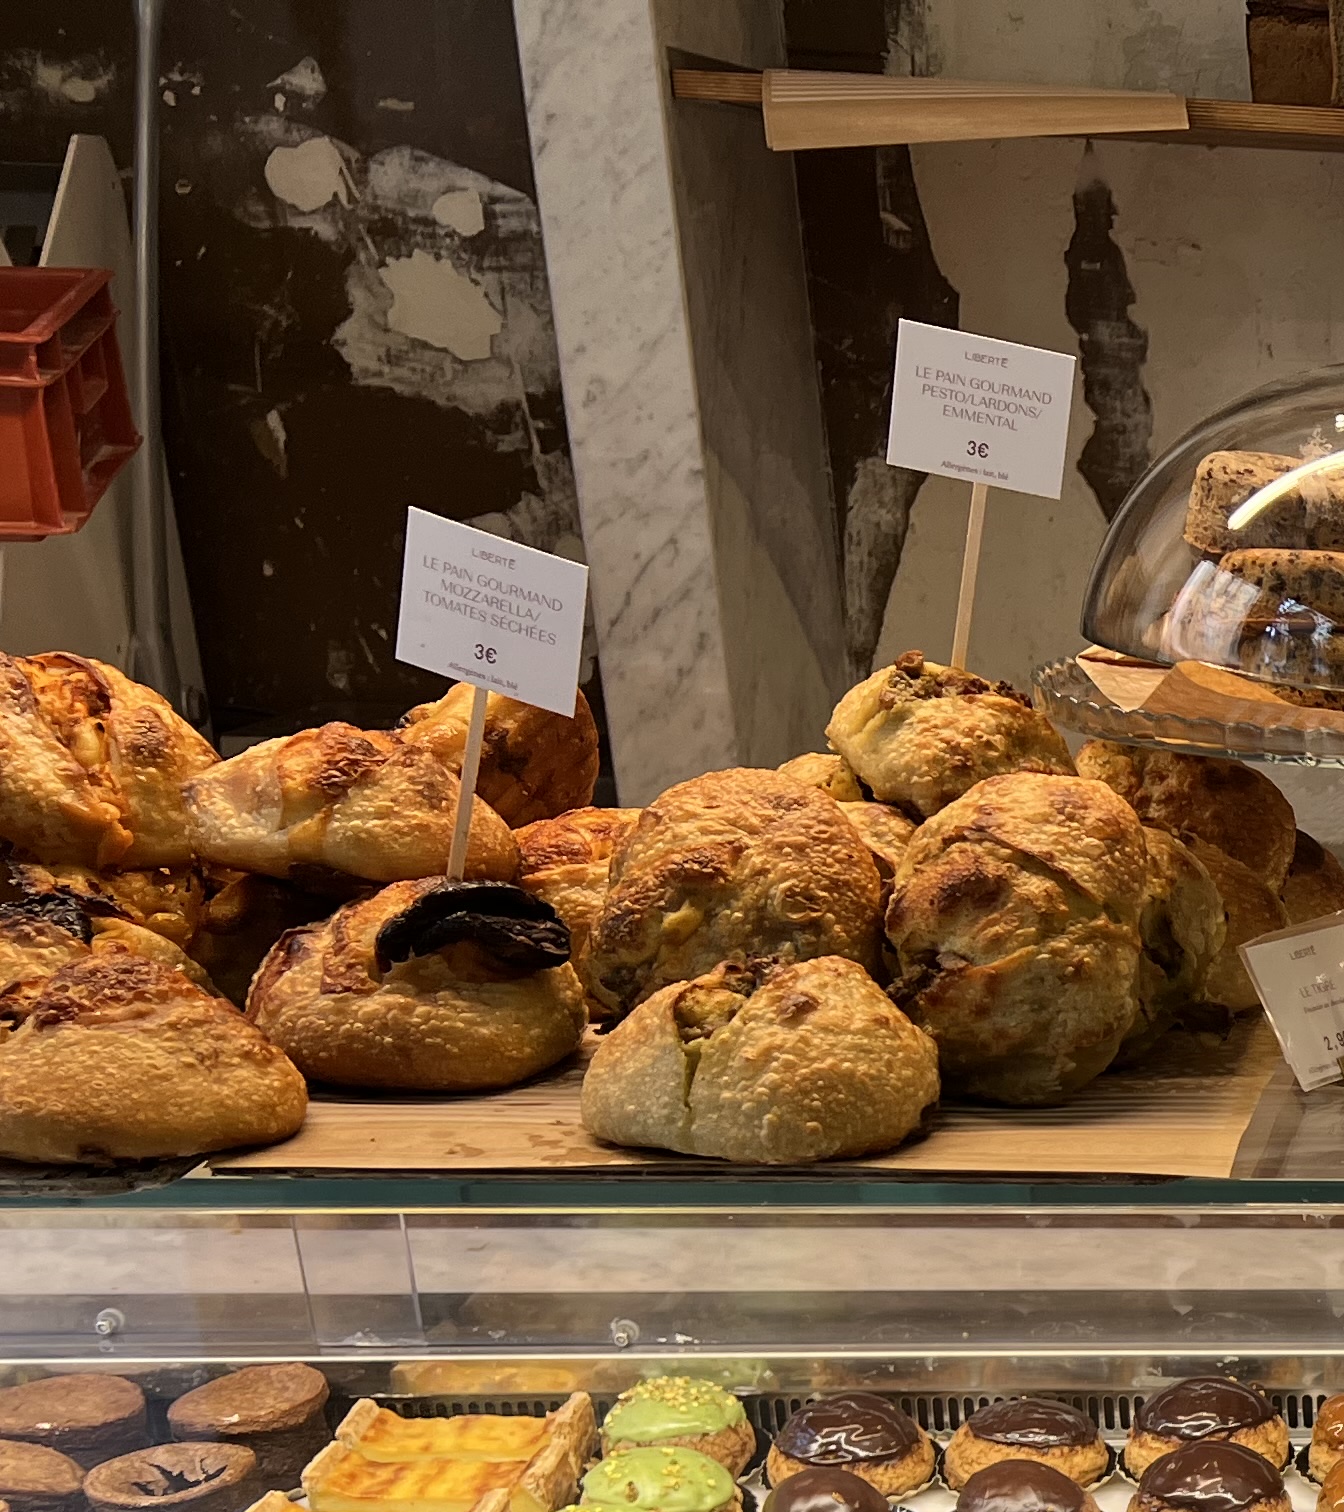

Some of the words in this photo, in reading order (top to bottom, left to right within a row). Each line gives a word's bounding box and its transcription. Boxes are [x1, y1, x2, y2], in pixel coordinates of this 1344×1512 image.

[915, 365, 932, 380] LE
[936, 368, 966, 386] PAIN
[969, 377, 1052, 405] GOURMAND
[922, 383, 1042, 419] PESTO/LARDONS/
[942, 404, 1018, 431] EMMENTAL
[966, 440, 989, 458] 3€
[423, 554, 438, 570] LE
[443, 561, 473, 582] PAIN
[477, 574, 563, 612] GOURMAND
[441, 579, 541, 621] MOZZARELLA/
[423, 590, 487, 622] TOMATES
[490, 612, 557, 646] SÉCHÉES
[474, 643, 497, 664] 3€
[1299, 985, 1309, 999] LE
